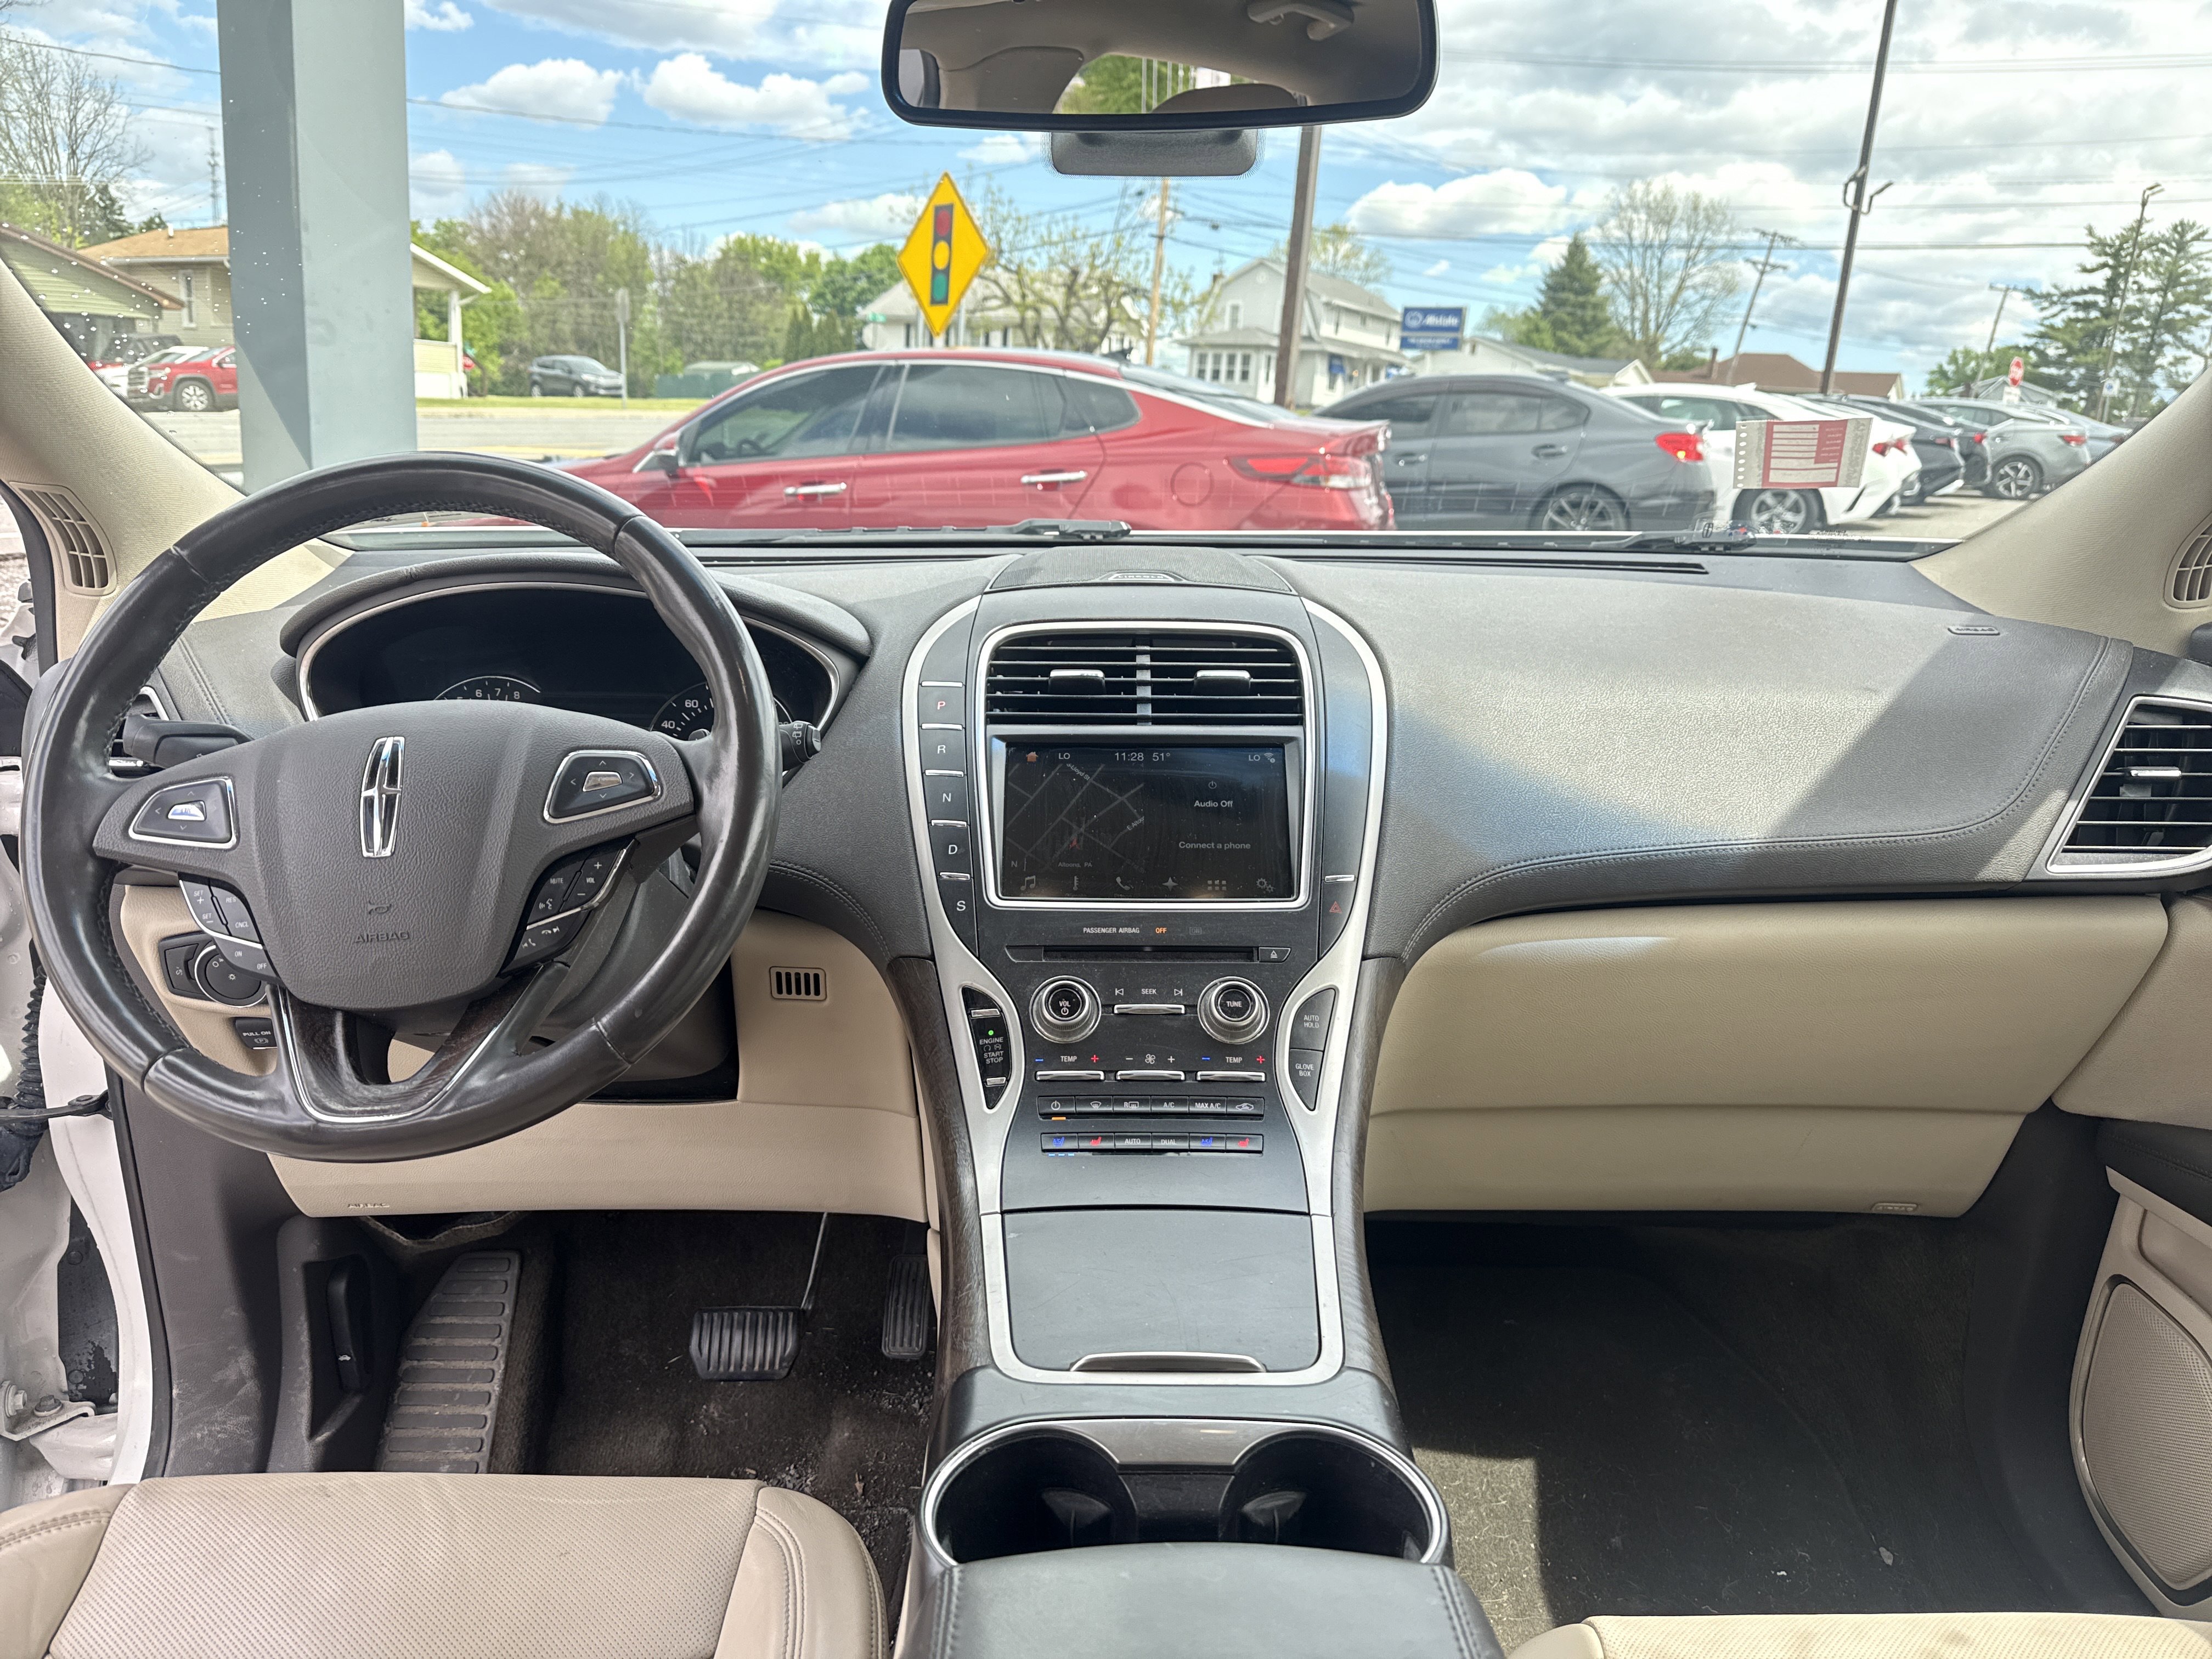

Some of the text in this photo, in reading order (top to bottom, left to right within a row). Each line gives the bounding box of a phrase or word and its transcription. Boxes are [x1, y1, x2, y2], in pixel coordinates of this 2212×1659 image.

[475, 689, 482, 698] 6
[494, 688, 501, 696] 7
[514, 691, 520, 699] 8
[685, 699, 698, 708] 60
[937, 701, 946, 710] P
[661, 720, 675, 729] 40
[937, 744, 946, 754] R
[1114, 752, 1144, 761] 11:28
[943, 793, 951, 803] N
[948, 844, 958, 855] D
[1224, 842, 1251, 850] phone
[956, 900, 966, 911] S
[355, 932, 410, 943] AIRBAG
[979, 1037, 1004, 1045] ENGINE
[984, 1051, 1004, 1059] START
